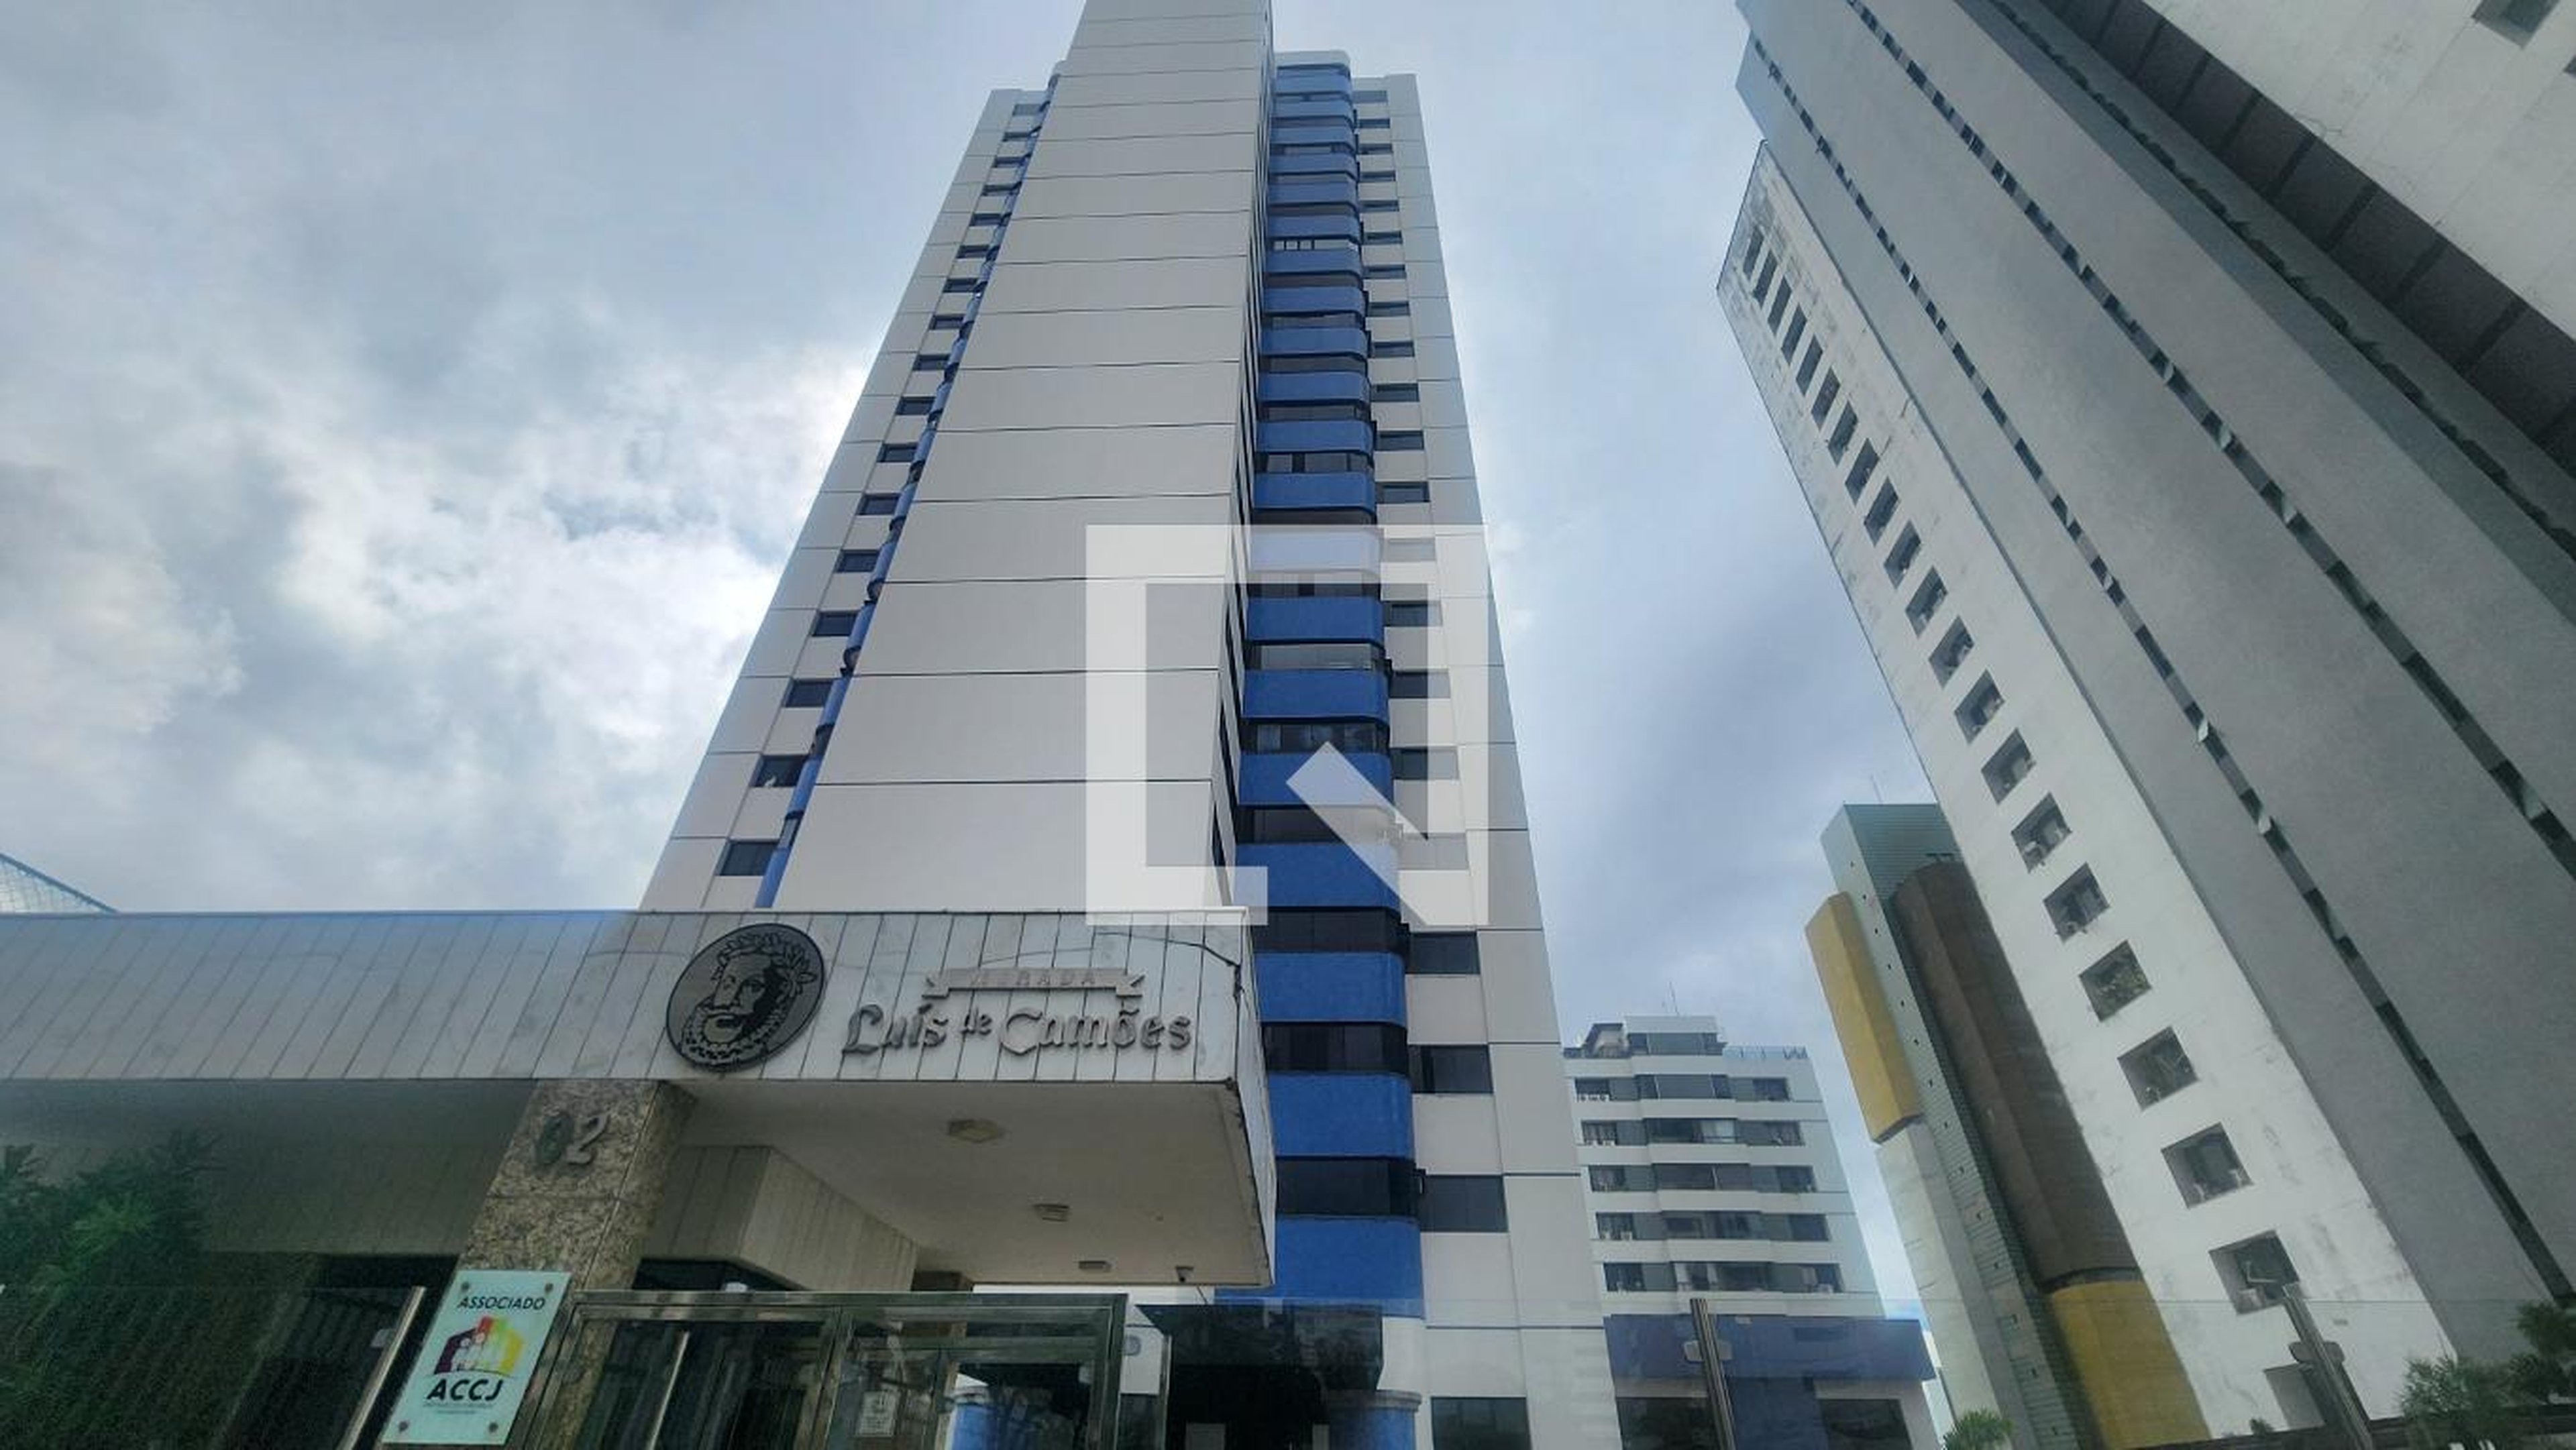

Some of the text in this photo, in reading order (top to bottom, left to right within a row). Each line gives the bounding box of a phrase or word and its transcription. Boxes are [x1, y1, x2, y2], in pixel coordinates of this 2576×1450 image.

[843, 1005, 1192, 1056] Luís de Camões
[457, 1296, 546, 1310] ASSOCIADO
[427, 1379, 503, 1401] ACCJ
